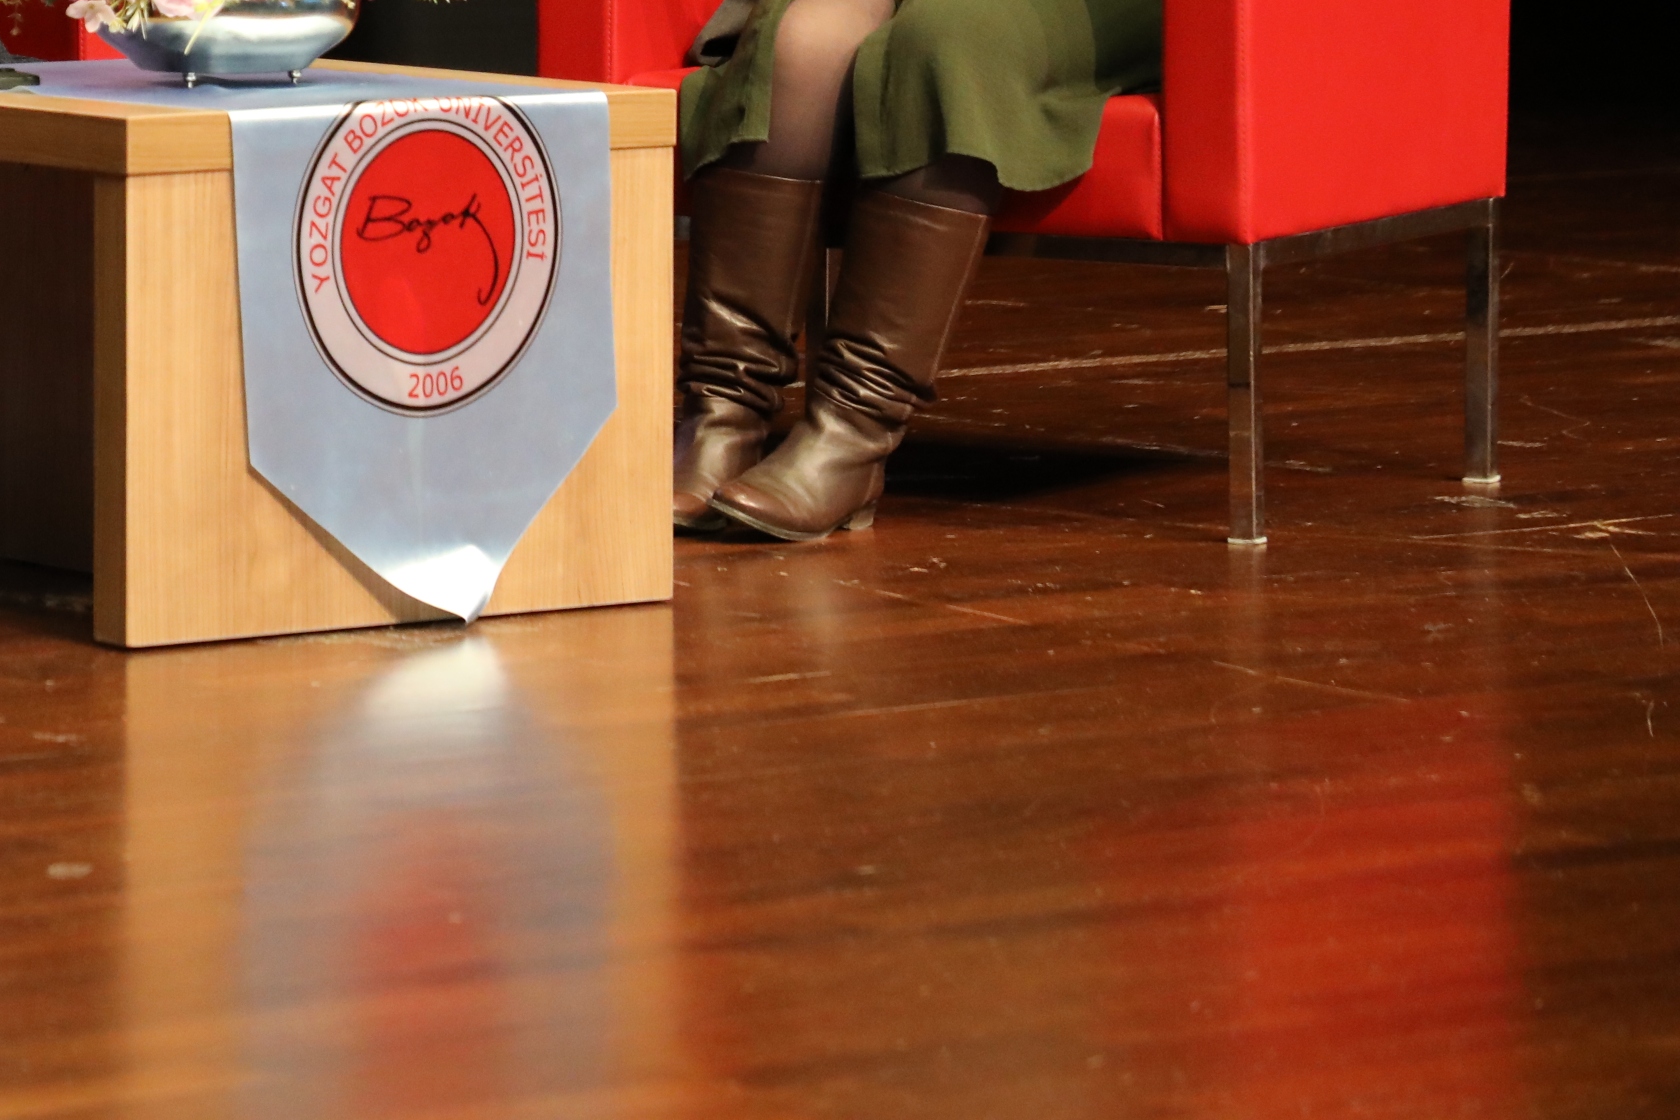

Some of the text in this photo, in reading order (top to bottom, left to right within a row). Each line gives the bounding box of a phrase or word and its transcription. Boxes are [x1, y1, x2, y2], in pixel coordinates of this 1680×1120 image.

[310, 154, 348, 293] YOZGAT
[344, 97, 427, 154] BOZOK
[407, 367, 464, 399] 2006
